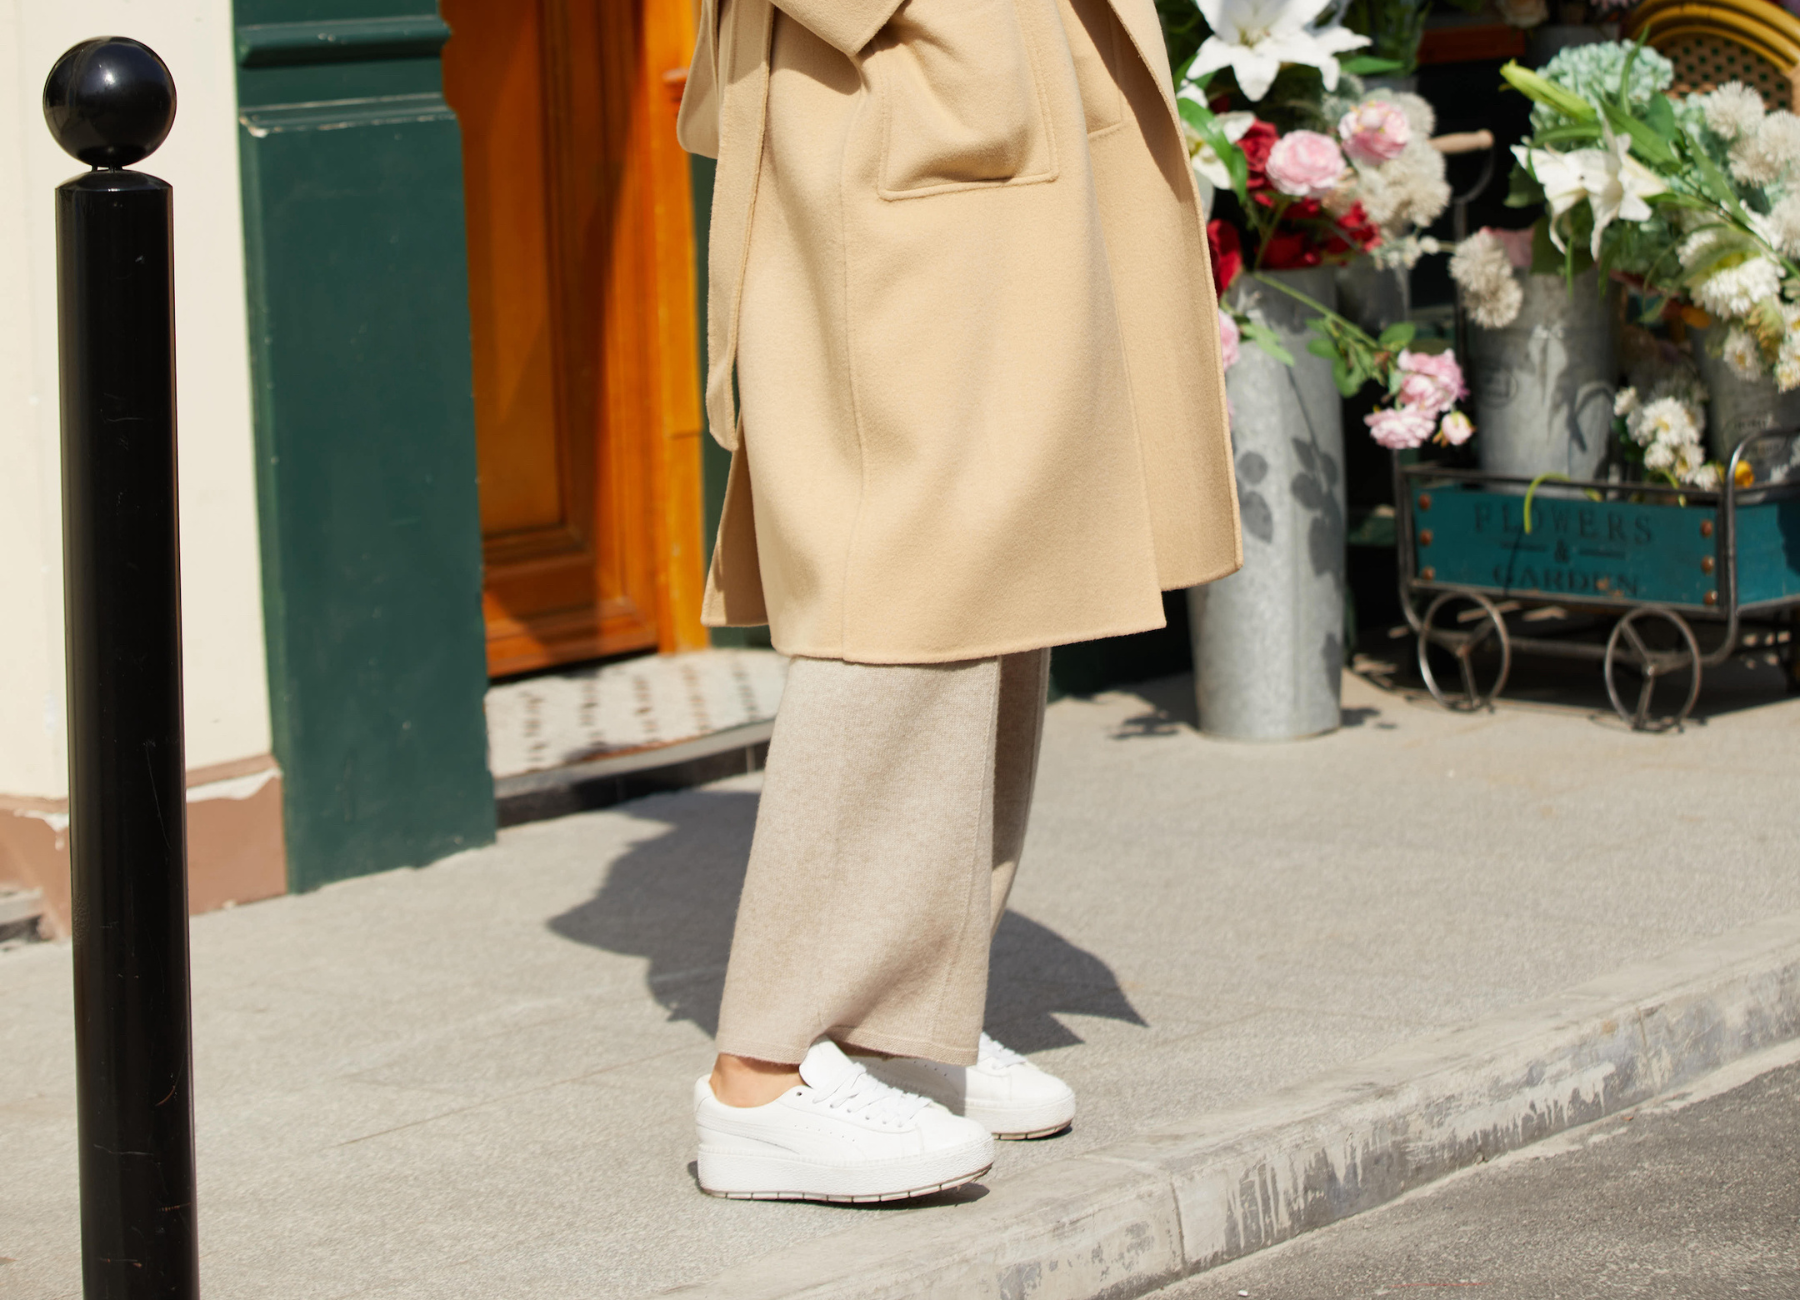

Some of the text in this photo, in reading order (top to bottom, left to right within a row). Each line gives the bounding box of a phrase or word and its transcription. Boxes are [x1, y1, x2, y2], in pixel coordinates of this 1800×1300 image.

[1473, 500, 1654, 546] FLOWERS
[1553, 538, 1570, 563] &
[1493, 564, 1639, 597] GARDEN
